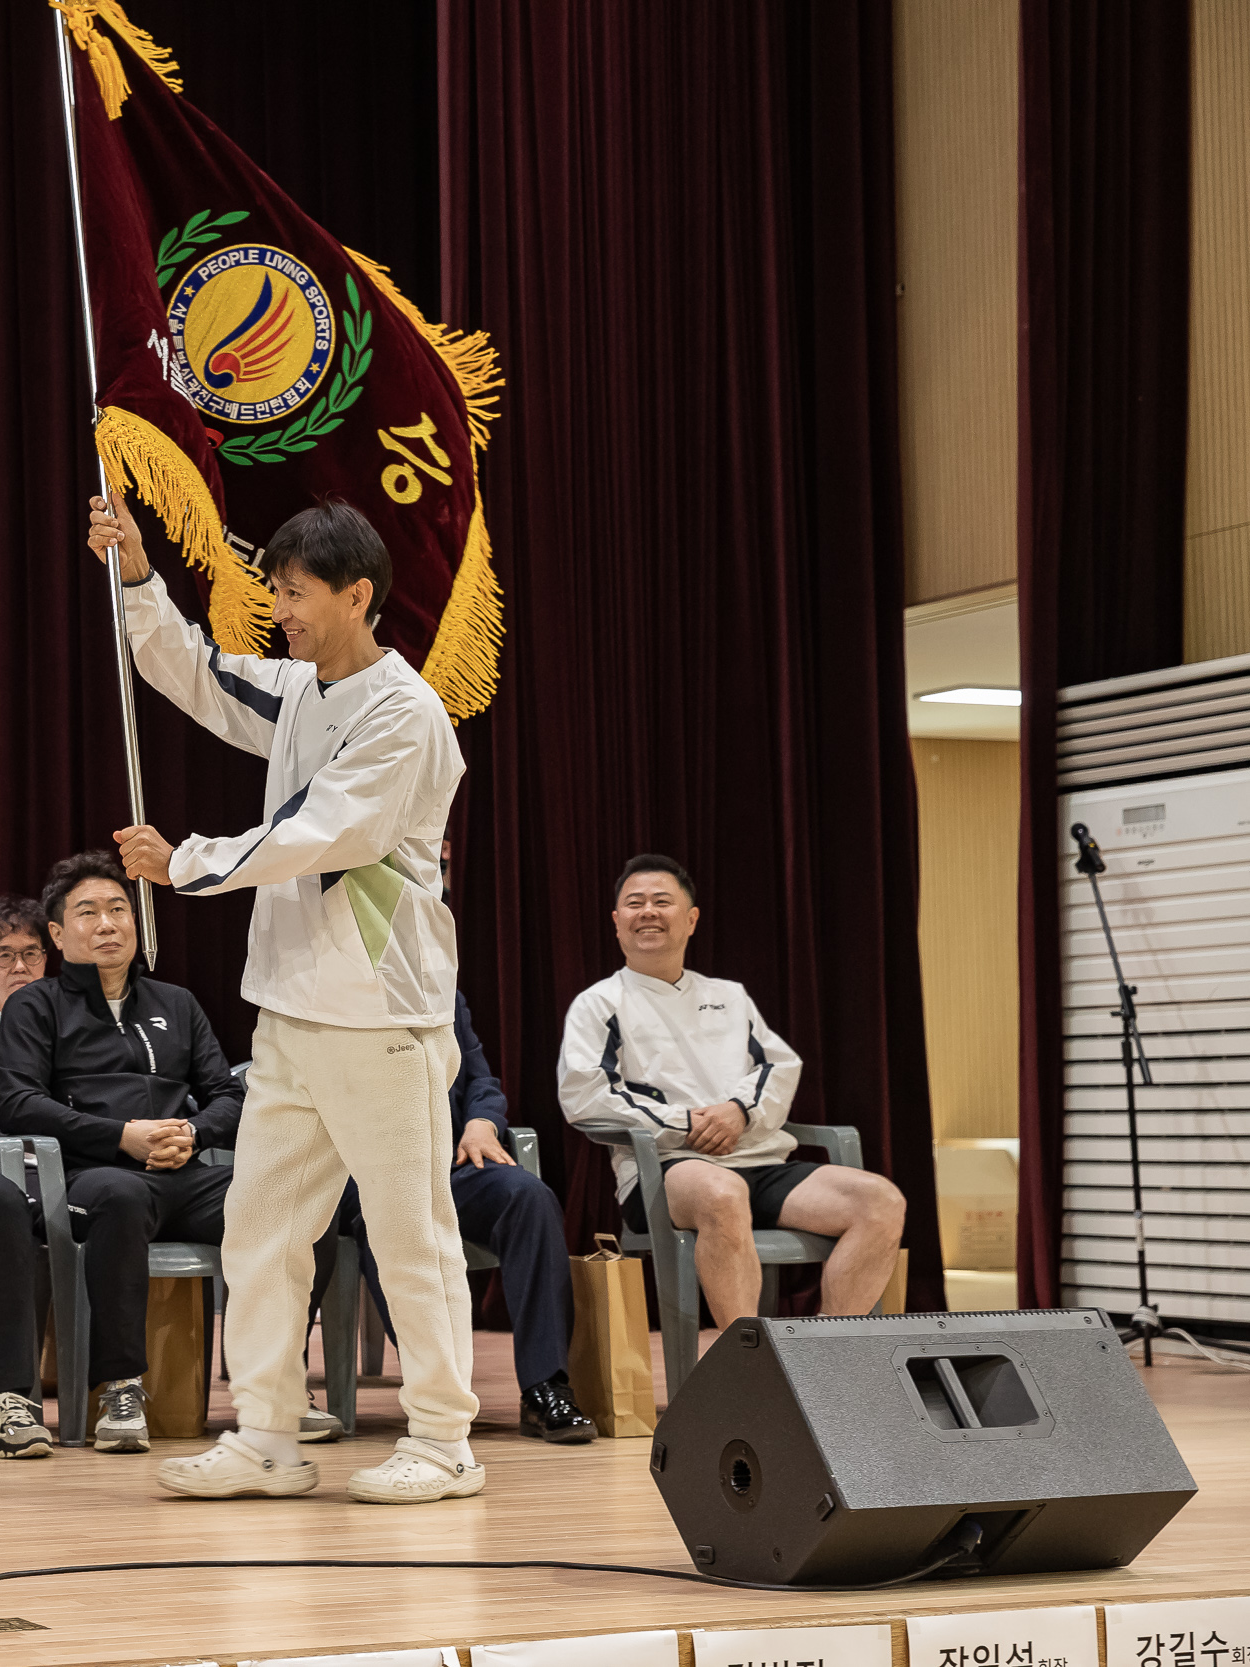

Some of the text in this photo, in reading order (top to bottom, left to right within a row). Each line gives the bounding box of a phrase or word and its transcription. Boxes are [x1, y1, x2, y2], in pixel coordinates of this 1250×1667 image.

[197, 249, 330, 351] PEOPLE LIVING SPORTS
[395, 1044, 415, 1052] Jeep
[393, 1475, 446, 1493] crocs
[1136, 1630, 1250, 1667] 강길수 회
